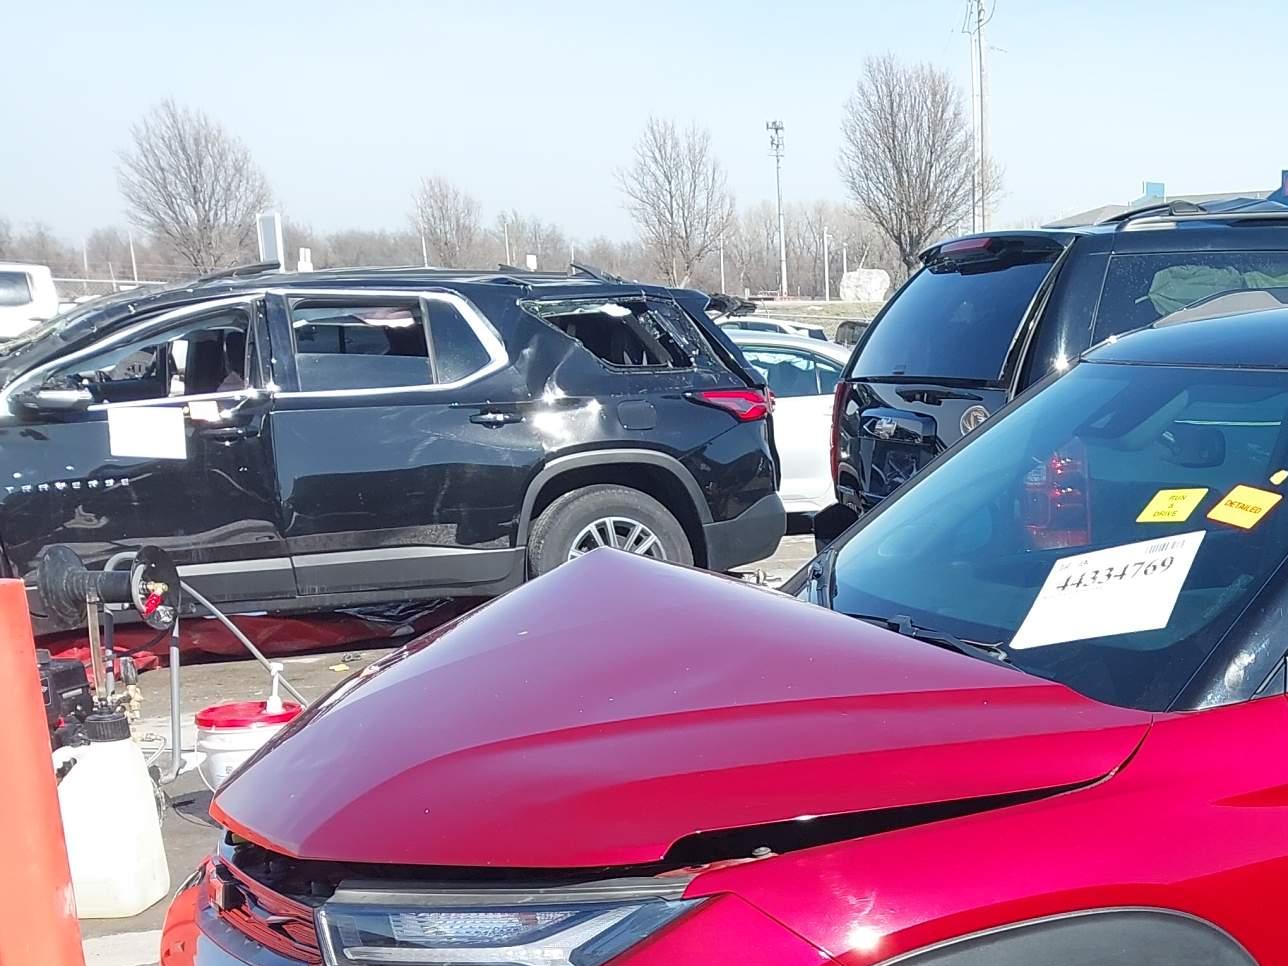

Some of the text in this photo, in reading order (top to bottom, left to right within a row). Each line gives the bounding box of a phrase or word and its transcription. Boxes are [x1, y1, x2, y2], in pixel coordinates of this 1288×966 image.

[4, 478, 129, 493] TRAVERSE
[1168, 494, 1188, 502] RUN
[1152, 509, 1179, 518] DRIVE
[1223, 499, 1262, 515] DETAILED
[1056, 556, 1174, 591] 44334769
